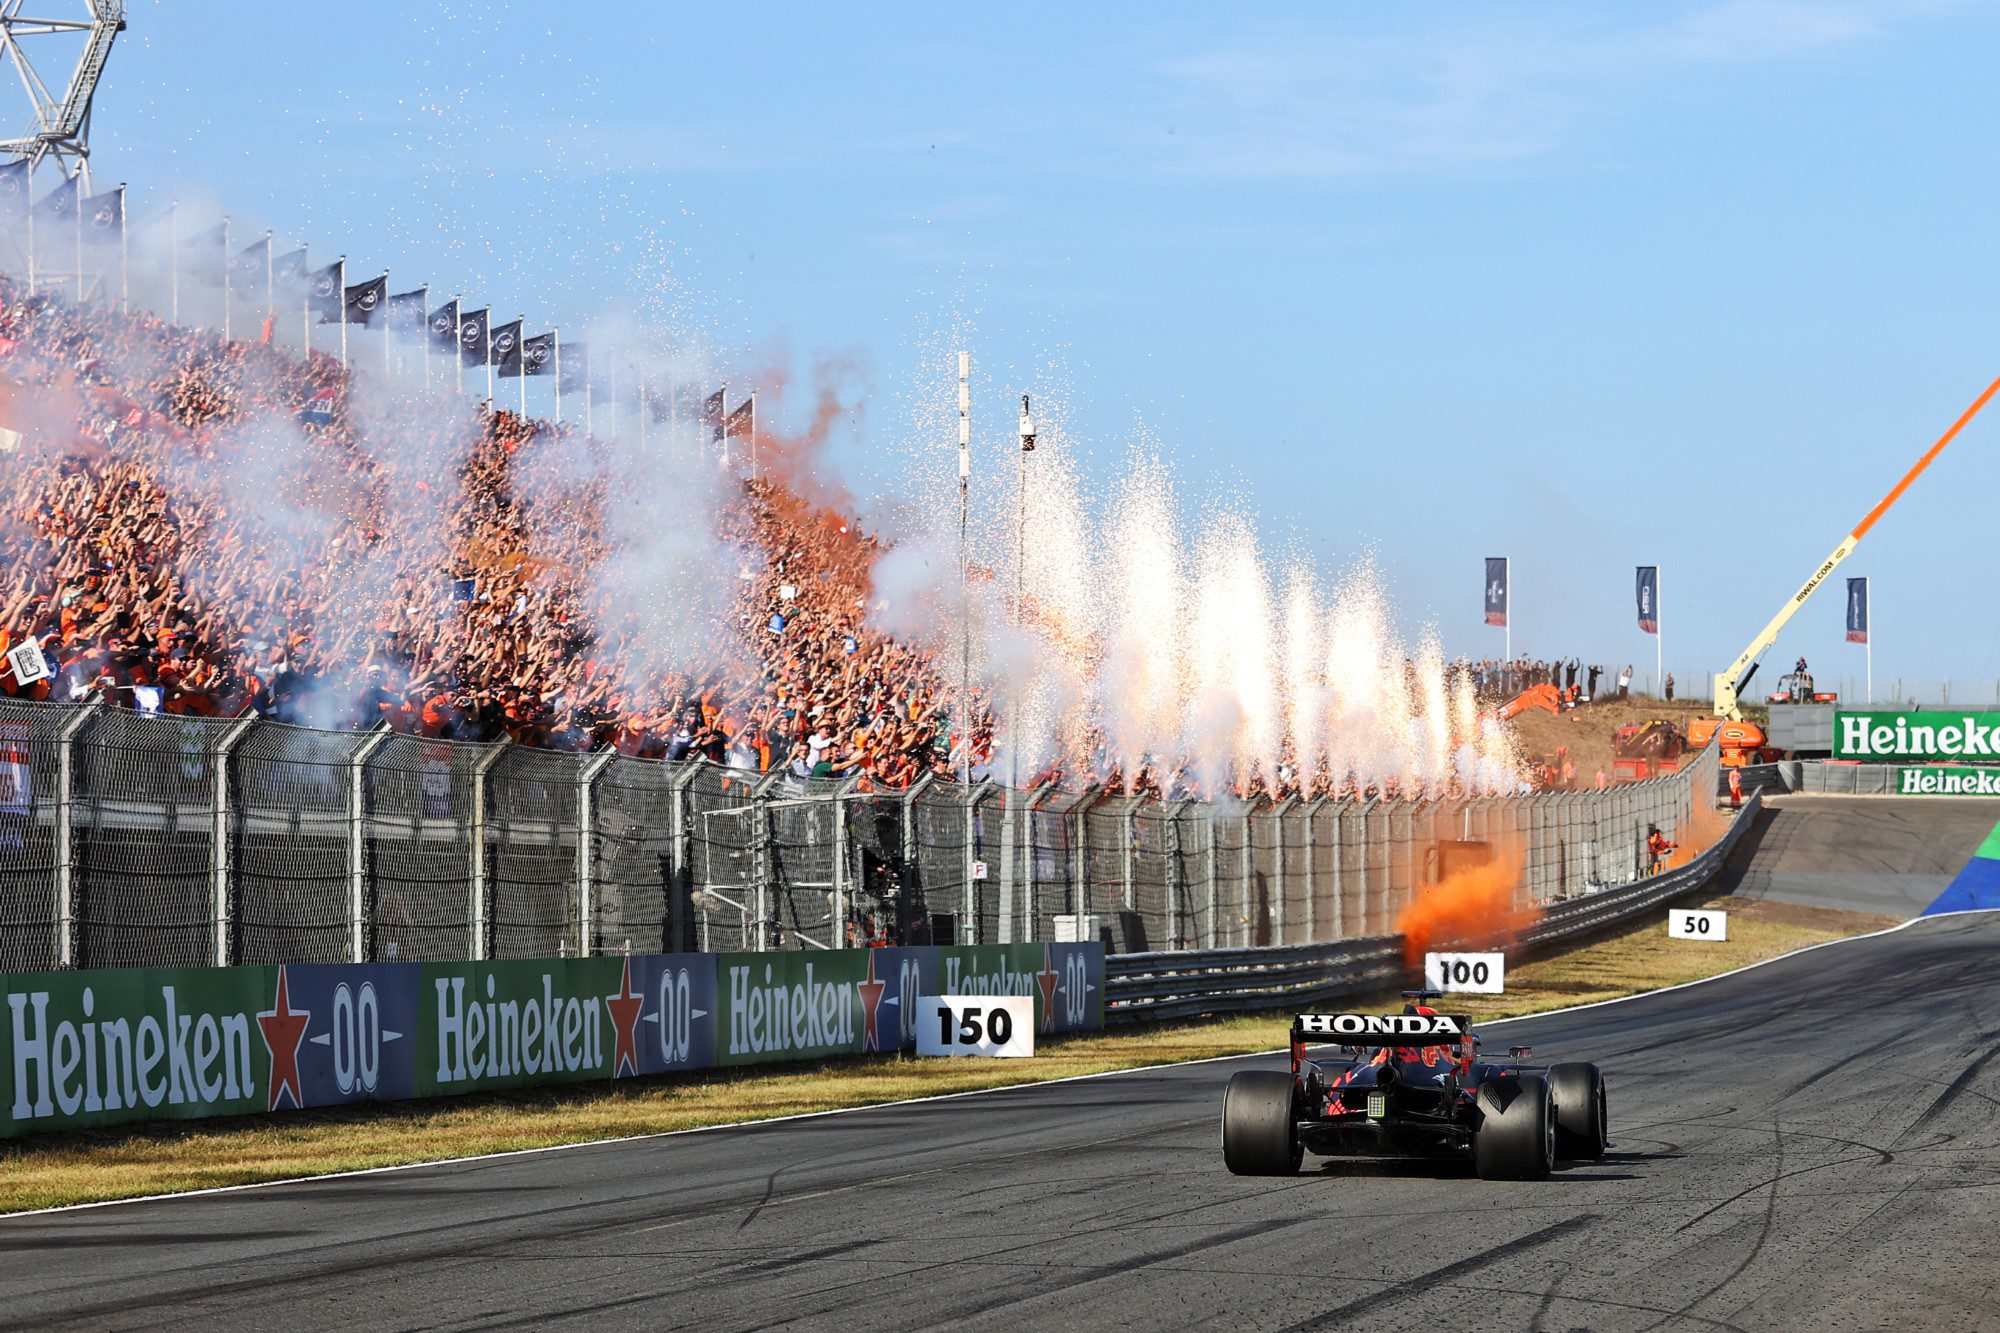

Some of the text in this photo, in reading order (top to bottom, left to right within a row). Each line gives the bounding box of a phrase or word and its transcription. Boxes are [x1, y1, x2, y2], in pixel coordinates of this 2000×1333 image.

[1796, 561, 1834, 602] RIWAL.COM
[976, 864, 984, 876] F
[1684, 916, 1710, 934] 50
[1440, 961, 1488, 985] 100
[435, 968, 690, 1083] Heineken 0.0
[729, 963, 854, 1055] Heineken
[937, 1007, 1013, 1045] 150
[1300, 1015, 1461, 1034] HONDA
[7, 981, 380, 1120] Heineken 0.0
